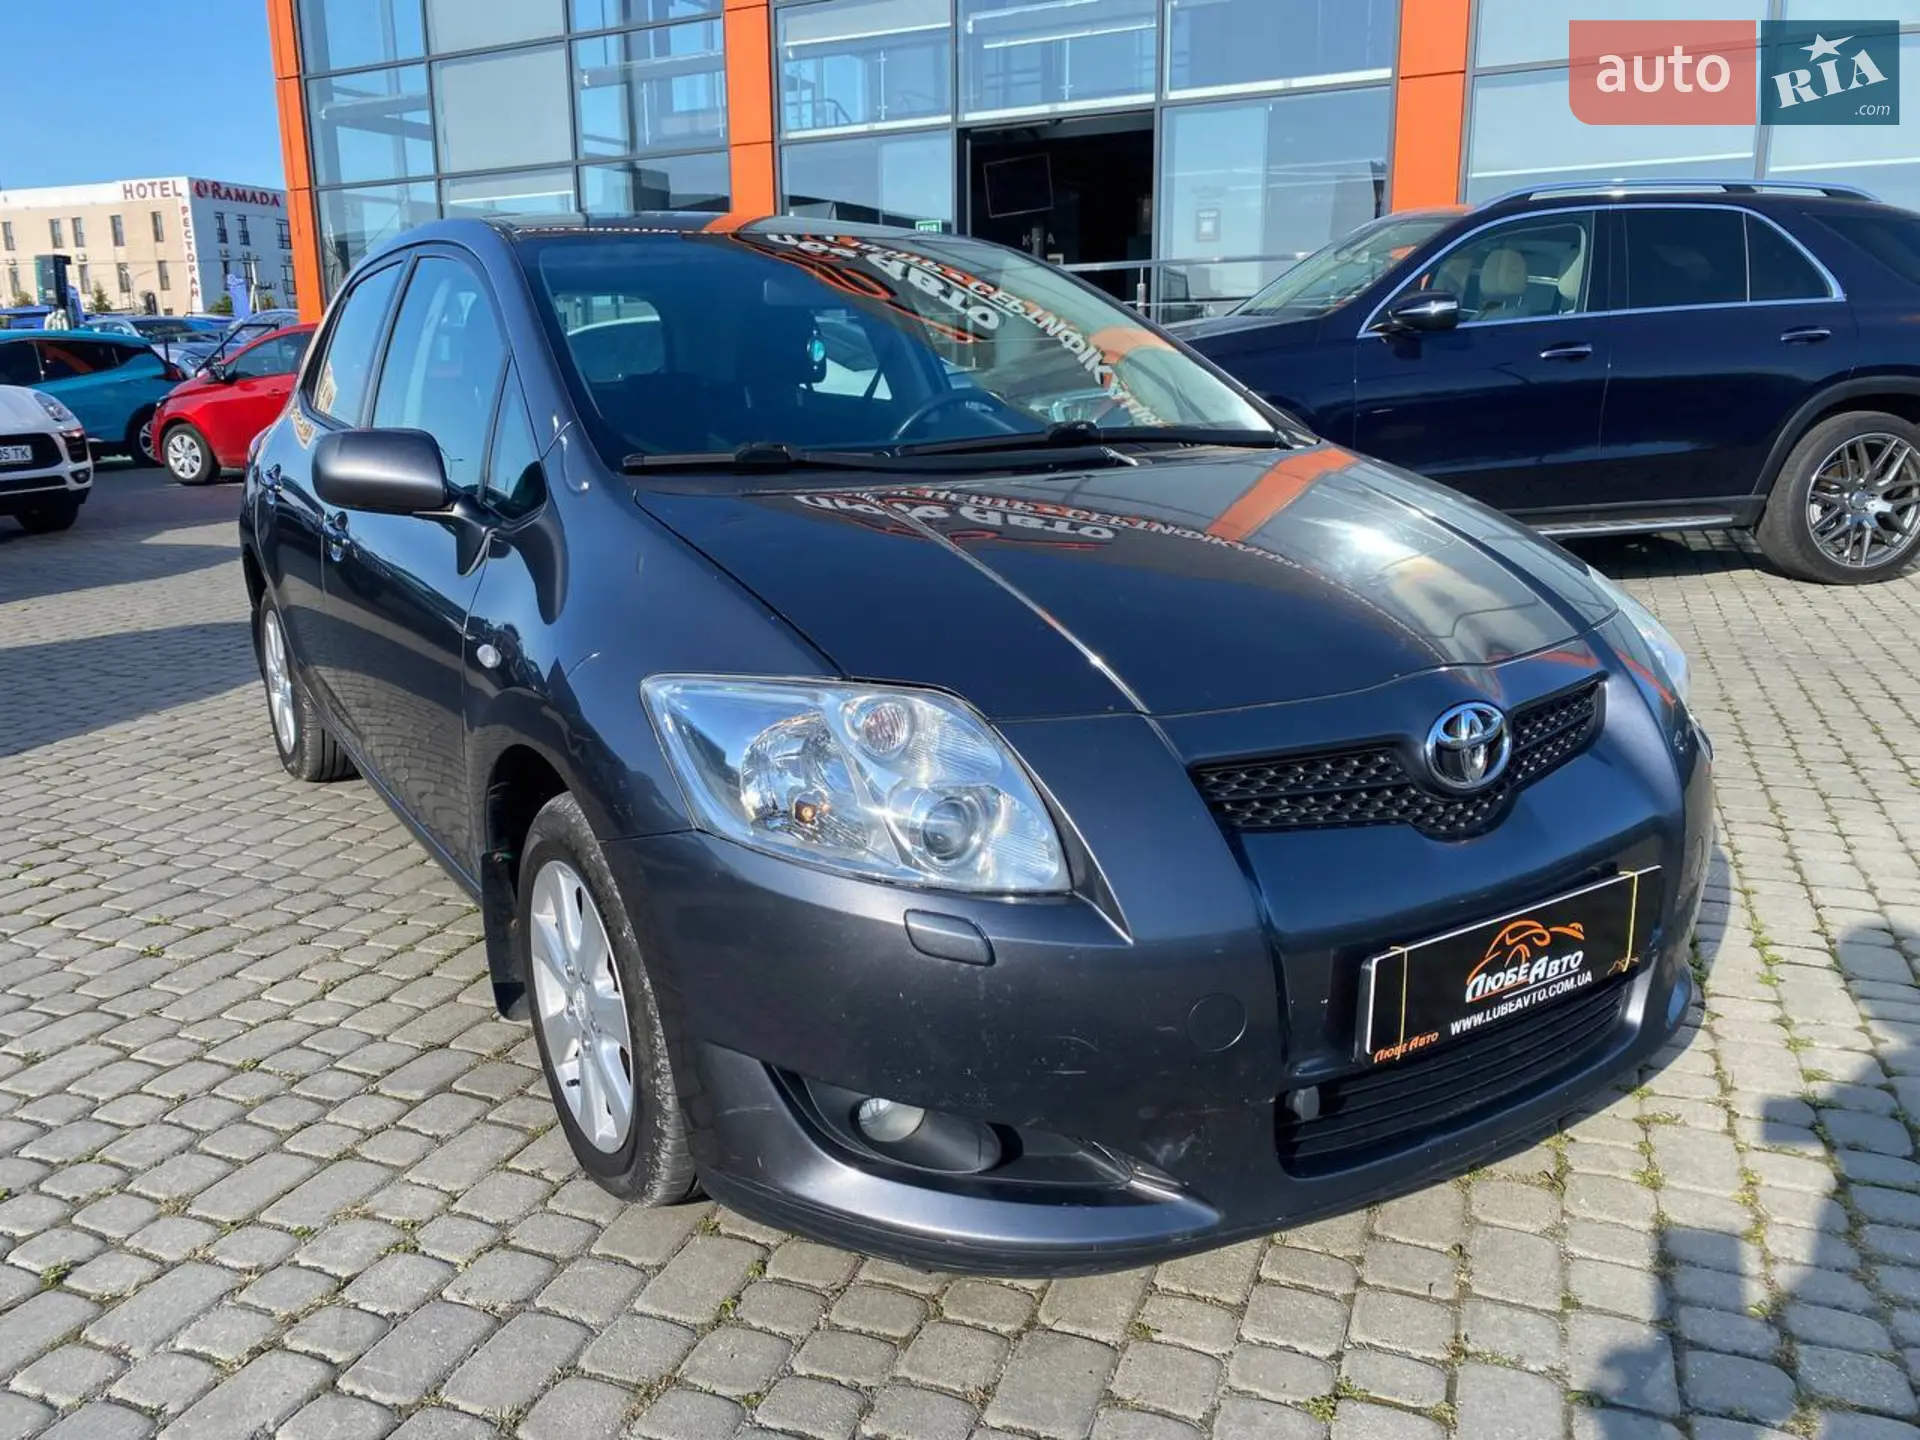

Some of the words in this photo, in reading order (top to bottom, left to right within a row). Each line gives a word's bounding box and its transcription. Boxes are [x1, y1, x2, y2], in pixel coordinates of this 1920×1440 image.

[123, 180, 182, 200] HOTEL
[211, 181, 280, 207] RAMADA
[180, 205, 200, 297] РЕСТОРАН
[1450, 969, 1593, 1036] WWW.LUBEAVTO.COM.UA
